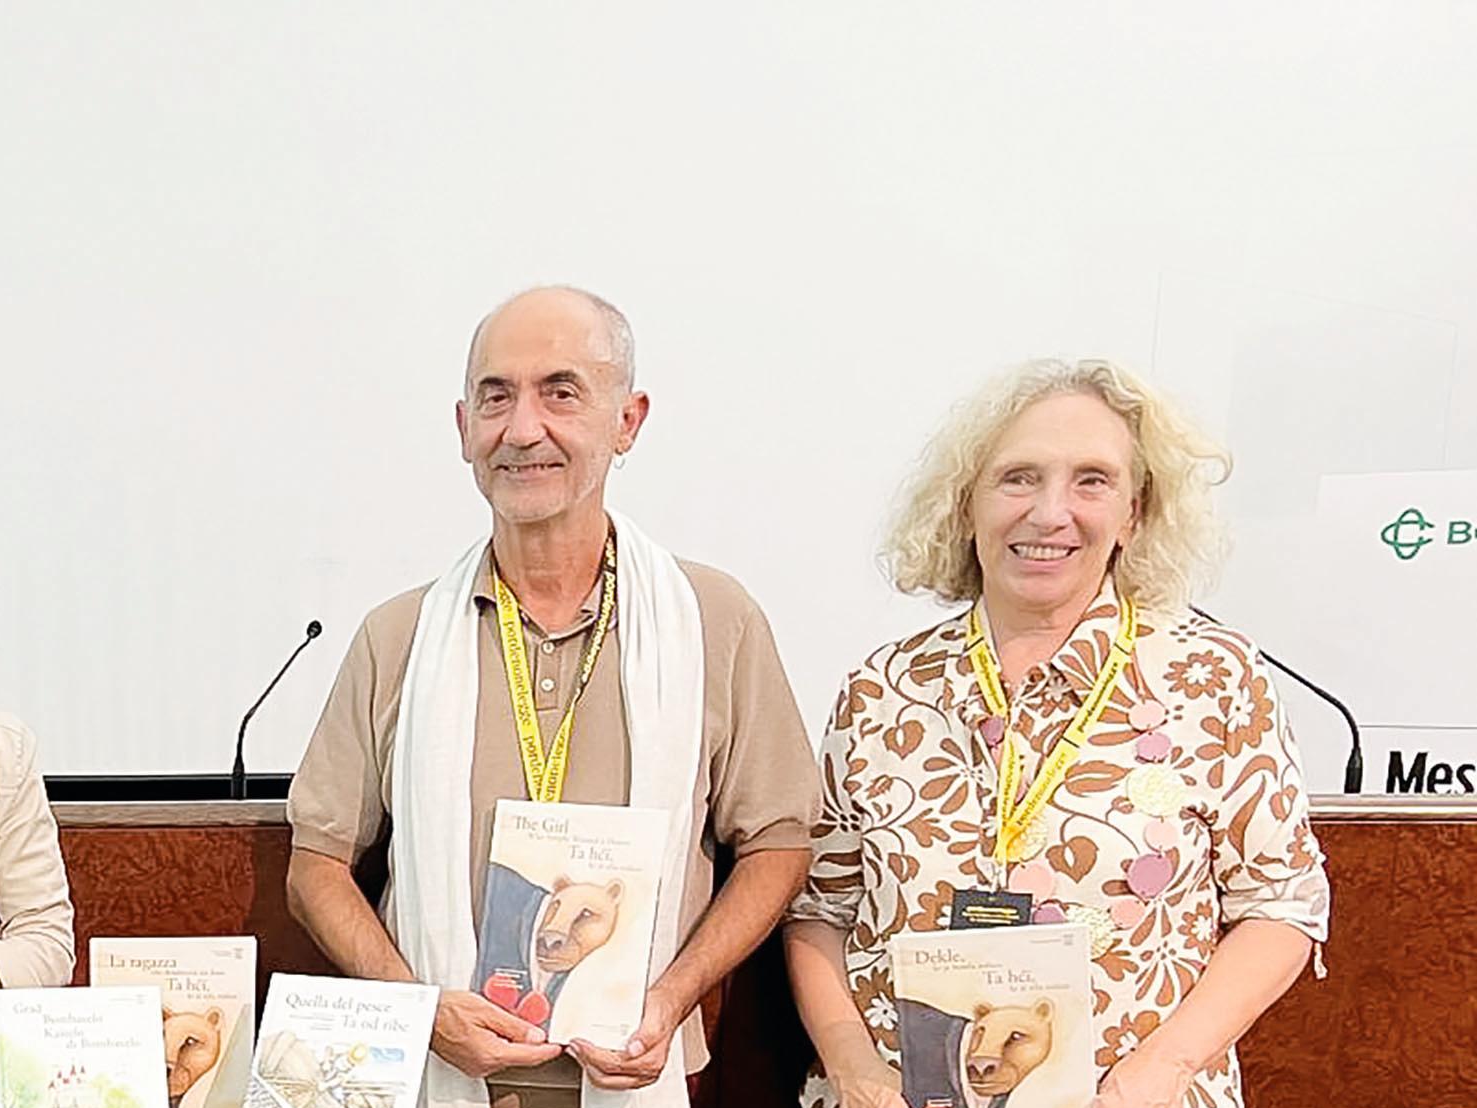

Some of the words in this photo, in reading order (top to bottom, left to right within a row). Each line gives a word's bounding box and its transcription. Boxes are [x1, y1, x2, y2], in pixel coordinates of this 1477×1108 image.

[1447, 520, 1477, 544] B
[504, 621, 531, 726] pordenonelegge
[514, 816, 538, 831] The
[542, 817, 570, 834] Girl
[569, 845, 585, 860] Ta
[109, 954, 125, 968] La
[130, 958, 177, 972] ragazza
[915, 948, 966, 964] Dekle,
[166, 977, 182, 991] Ta
[984, 971, 1003, 985] Ta
[286, 993, 328, 1009] Quella
[332, 996, 353, 1010] del
[355, 1003, 393, 1015] pesce
[341, 1014, 357, 1028] Ta
[361, 1017, 379, 1030] od
[383, 1019, 410, 1032] ribe
